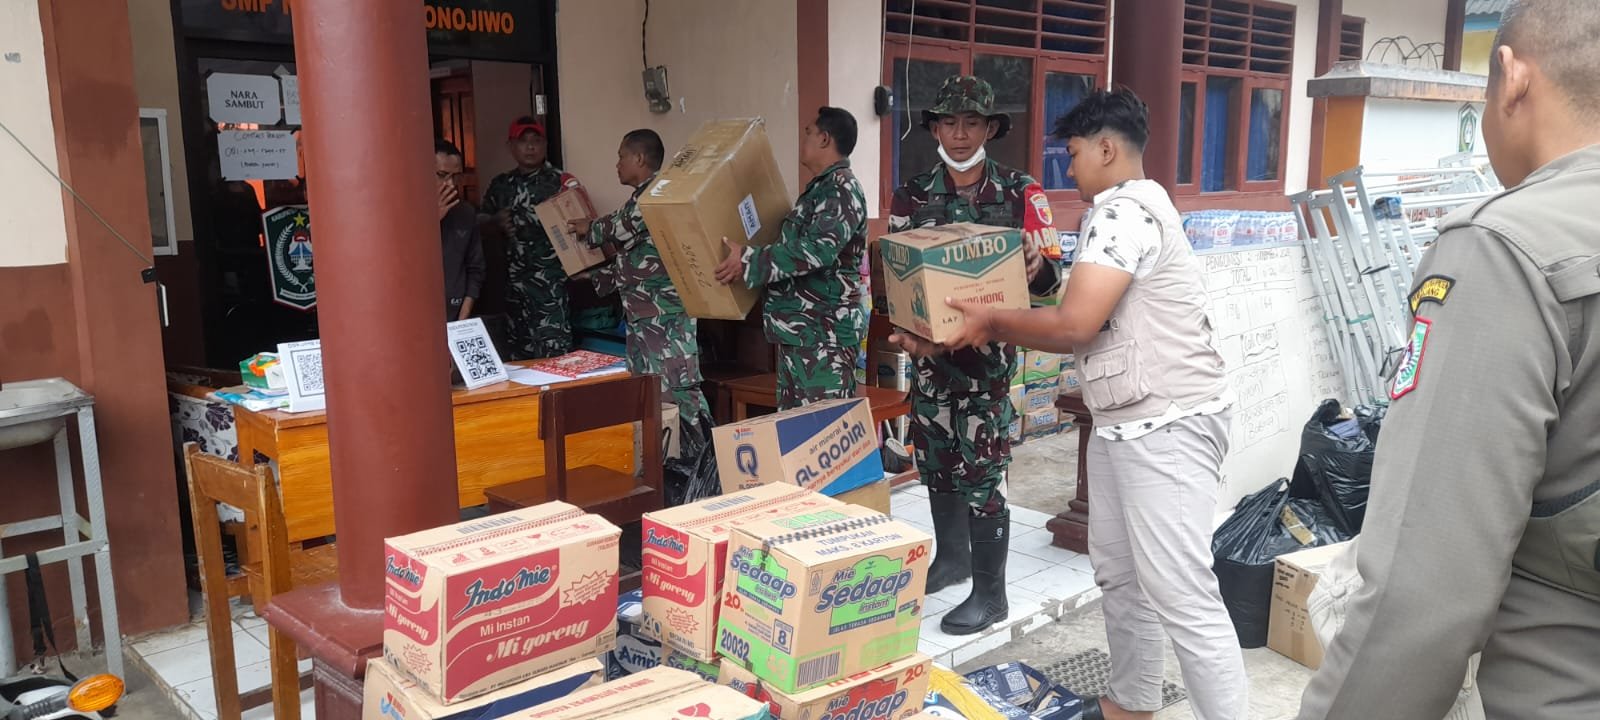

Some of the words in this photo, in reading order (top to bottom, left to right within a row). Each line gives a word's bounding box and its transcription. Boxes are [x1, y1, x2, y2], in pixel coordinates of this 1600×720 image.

[424, 5, 514, 34] ONOJIWO
[225, 99, 265, 109] SAMBUT
[231, 90, 258, 100] NARA
[942, 235, 1007, 265] JUMBO
[816, 530, 876, 547] TUMPUKAN
[853, 540, 861, 549] 8
[862, 533, 902, 549] KARTON
[731, 553, 797, 598] Sedaap
[834, 568, 856, 582] Mie
[815, 570, 913, 613] Sedaap
[480, 625, 494, 638] Mi
[496, 615, 531, 631] Instan
[778, 629, 787, 646] 8
[486, 635, 519, 663] Mi
[521, 619, 590, 656] goreng
[720, 628, 750, 660] 20032
[821, 689, 908, 720] daap
[827, 695, 850, 711] Mie
